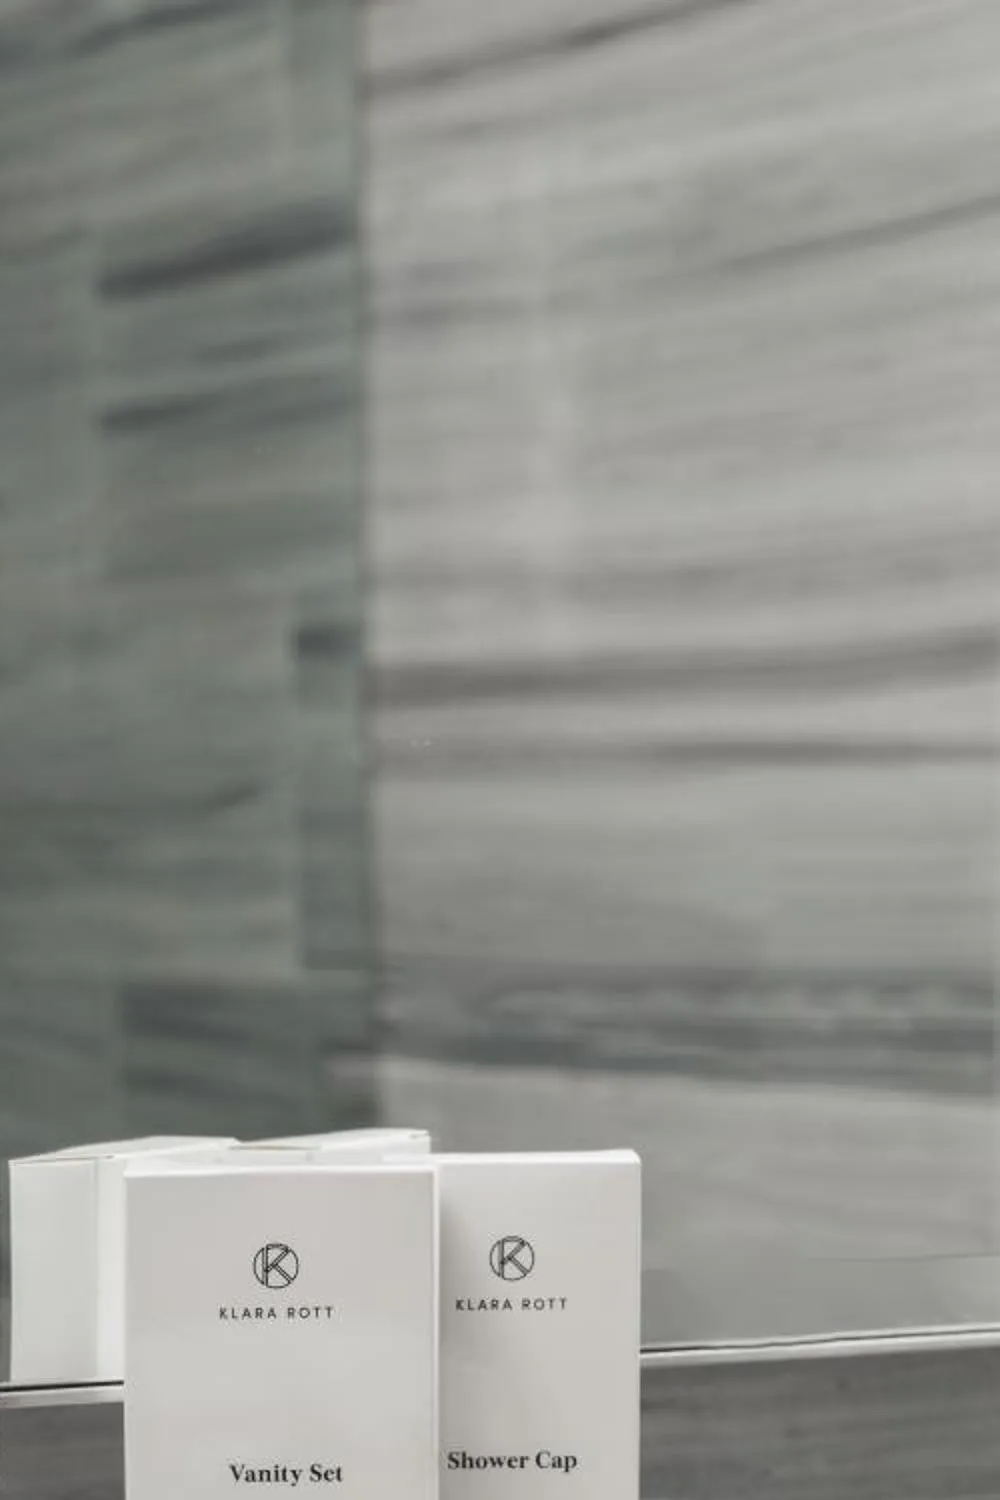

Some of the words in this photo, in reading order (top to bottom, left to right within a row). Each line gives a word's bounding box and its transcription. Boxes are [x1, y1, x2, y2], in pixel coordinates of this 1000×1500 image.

[220, 1307, 276, 1320] KLARA
[288, 1306, 333, 1319] ROTT
[455, 1299, 512, 1311] KLARA
[522, 1298, 566, 1310] ROTT
[447, 1451, 528, 1469] Shower
[535, 1452, 577, 1472] Cap
[230, 1464, 302, 1486] Vanity
[310, 1464, 343, 1483] Set
